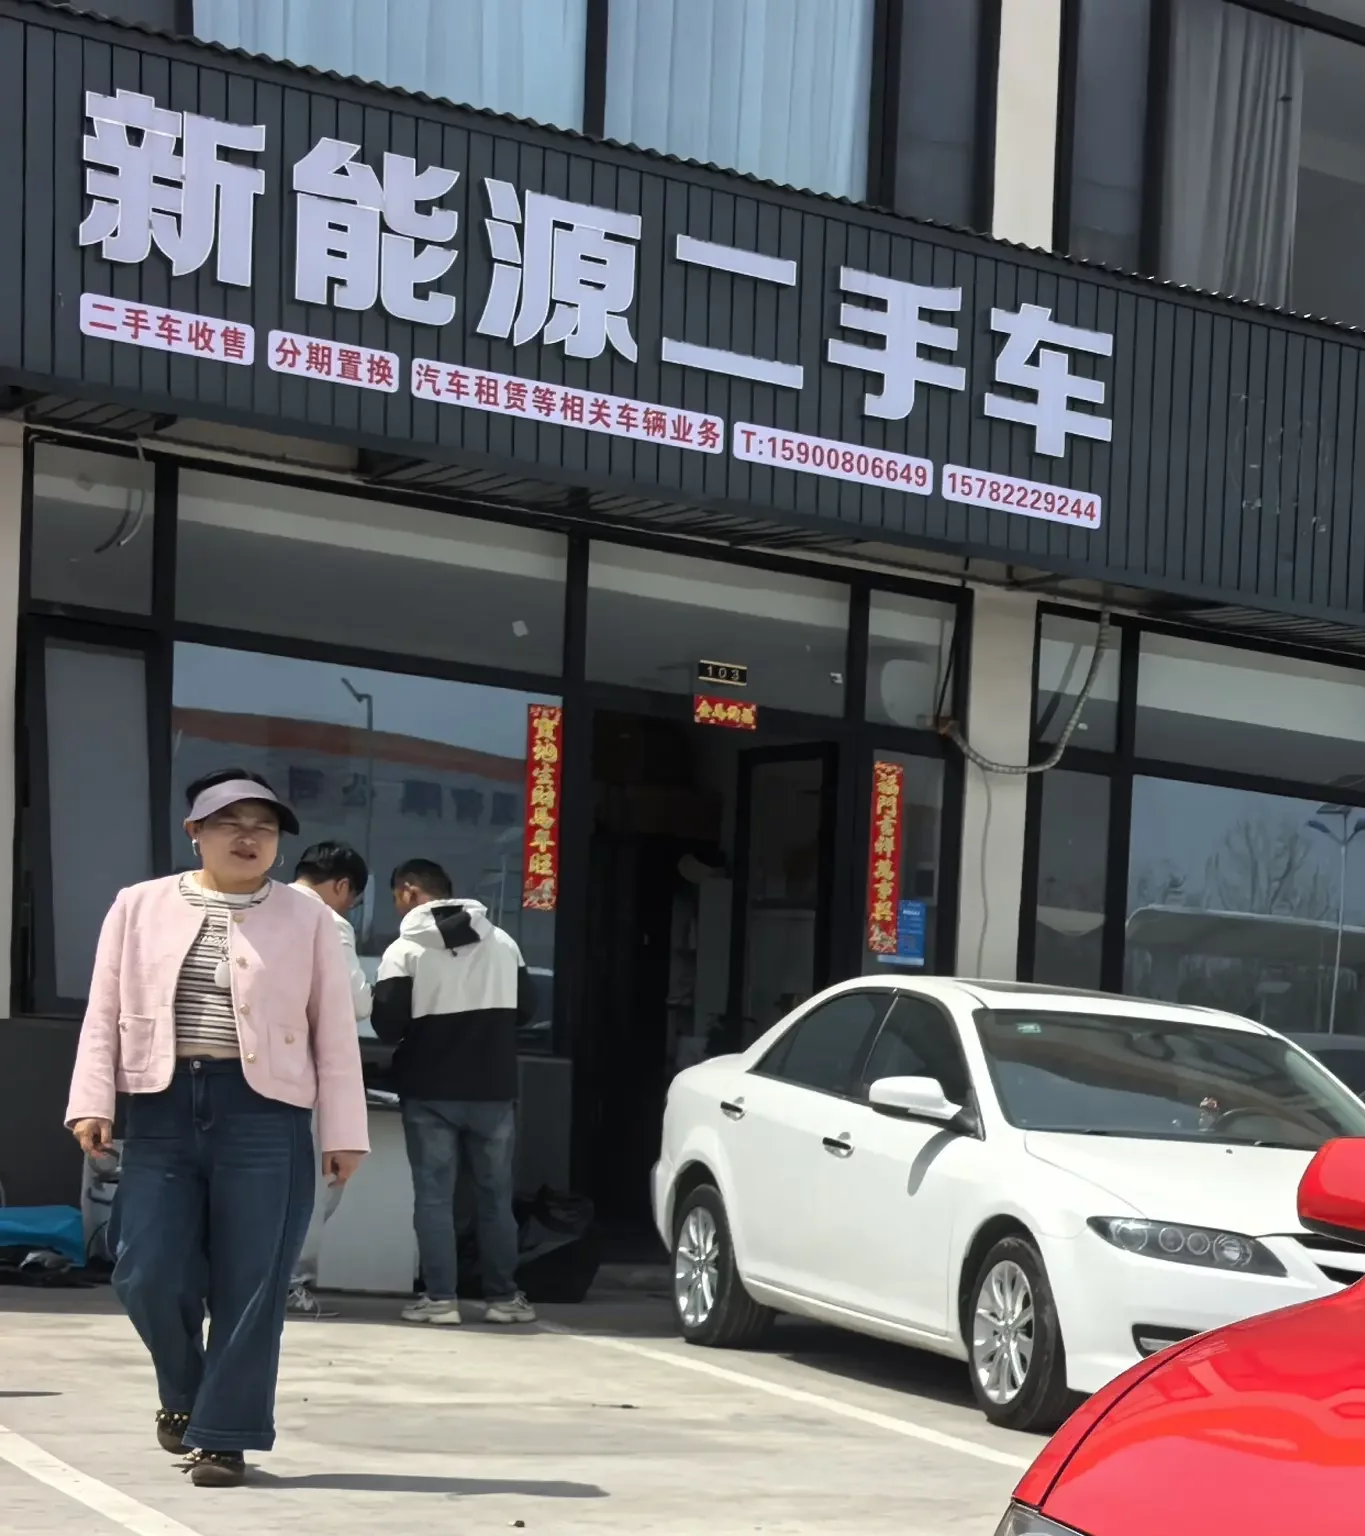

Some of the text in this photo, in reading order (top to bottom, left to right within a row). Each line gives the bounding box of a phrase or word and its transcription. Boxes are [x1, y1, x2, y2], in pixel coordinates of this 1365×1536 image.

[78, 88, 1114, 458] 新能源二手车
[88, 302, 1098, 522] 二手车收售 分期置换 汽车租赁等相关车辆业务 T:15900806649 15782229244
[706, 665, 740, 681] 103
